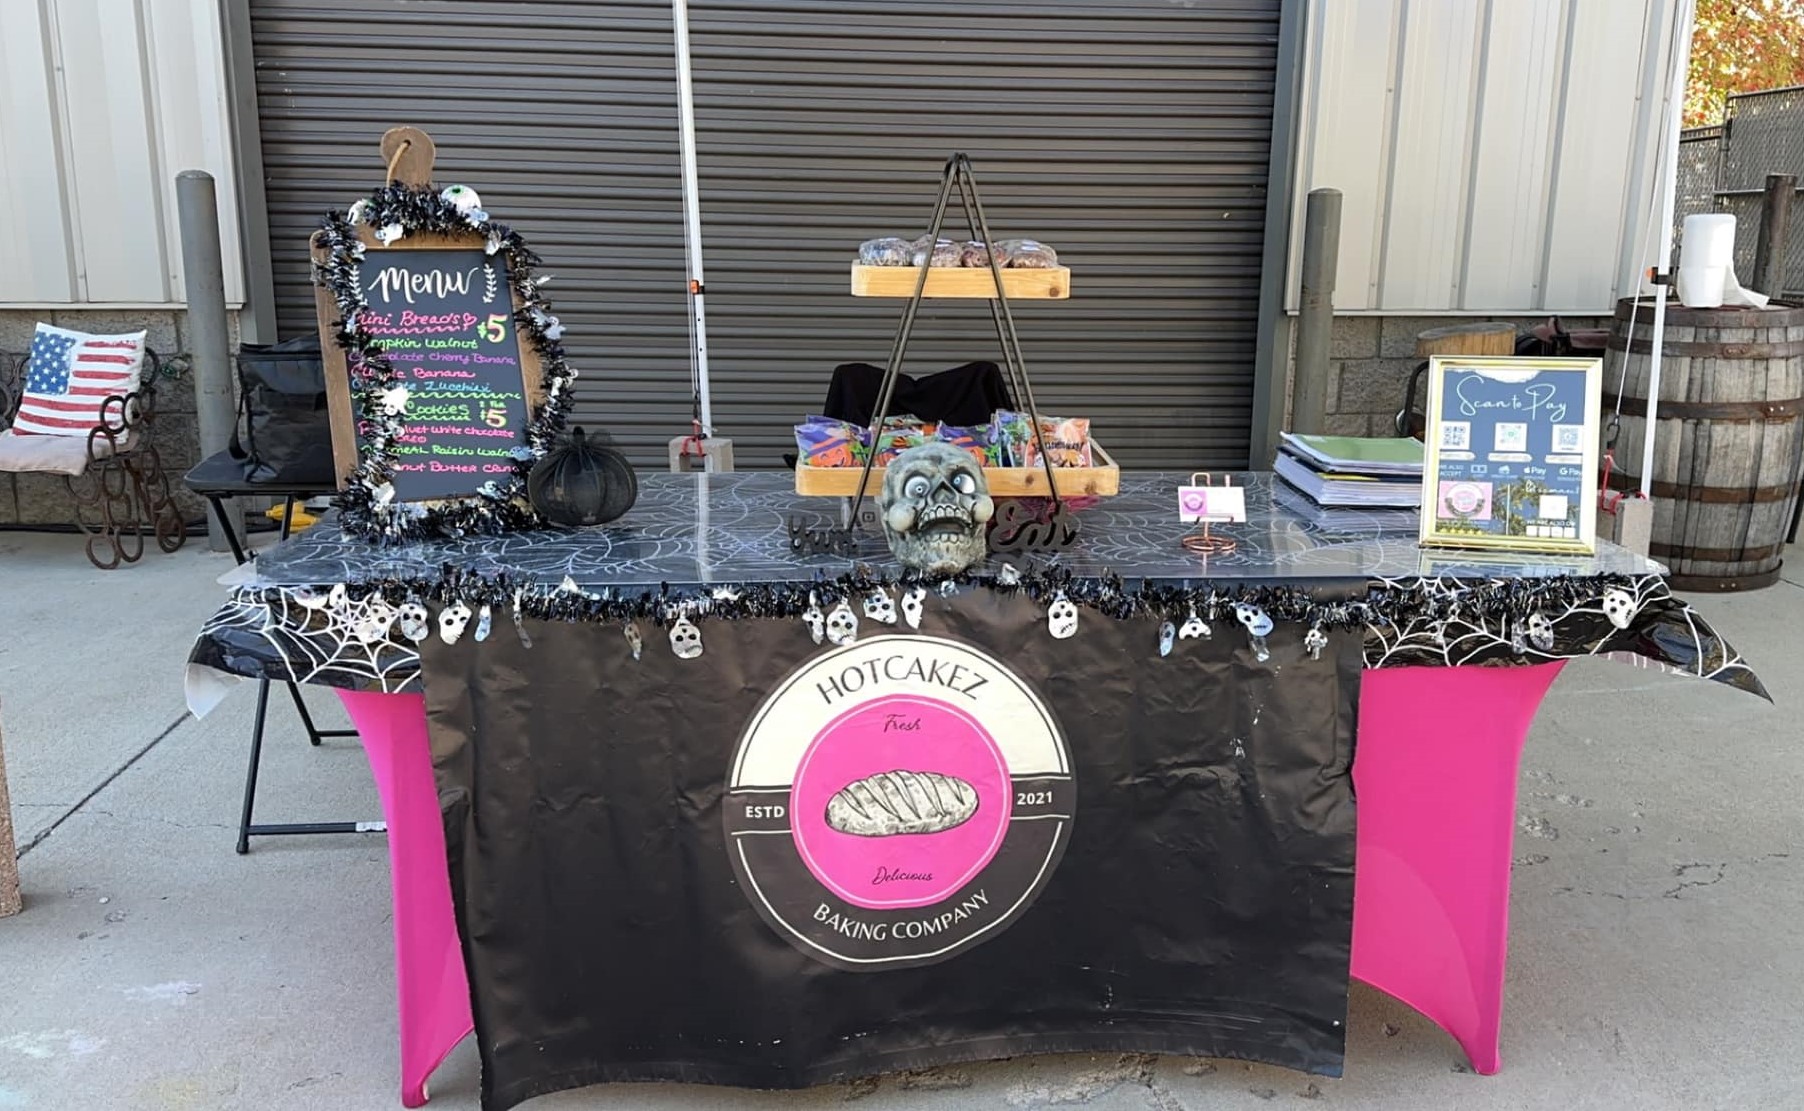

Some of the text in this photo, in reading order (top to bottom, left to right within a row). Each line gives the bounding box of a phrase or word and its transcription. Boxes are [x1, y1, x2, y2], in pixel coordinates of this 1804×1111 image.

[368, 266, 478, 304] Menu
[400, 310, 461, 325] Breads
[477, 313, 508, 343] $5
[369, 338, 422, 352] mpkin
[1456, 375, 1567, 423] Scan to Pay
[815, 655, 989, 705] HOTCAKEZ
[882, 713, 923, 733] Fresh
[745, 804, 785, 819] ESTD
[1017, 791, 1053, 806] 2021
[872, 865, 934, 886] Delicious
[813, 888, 991, 942] BAKING COMPANY
